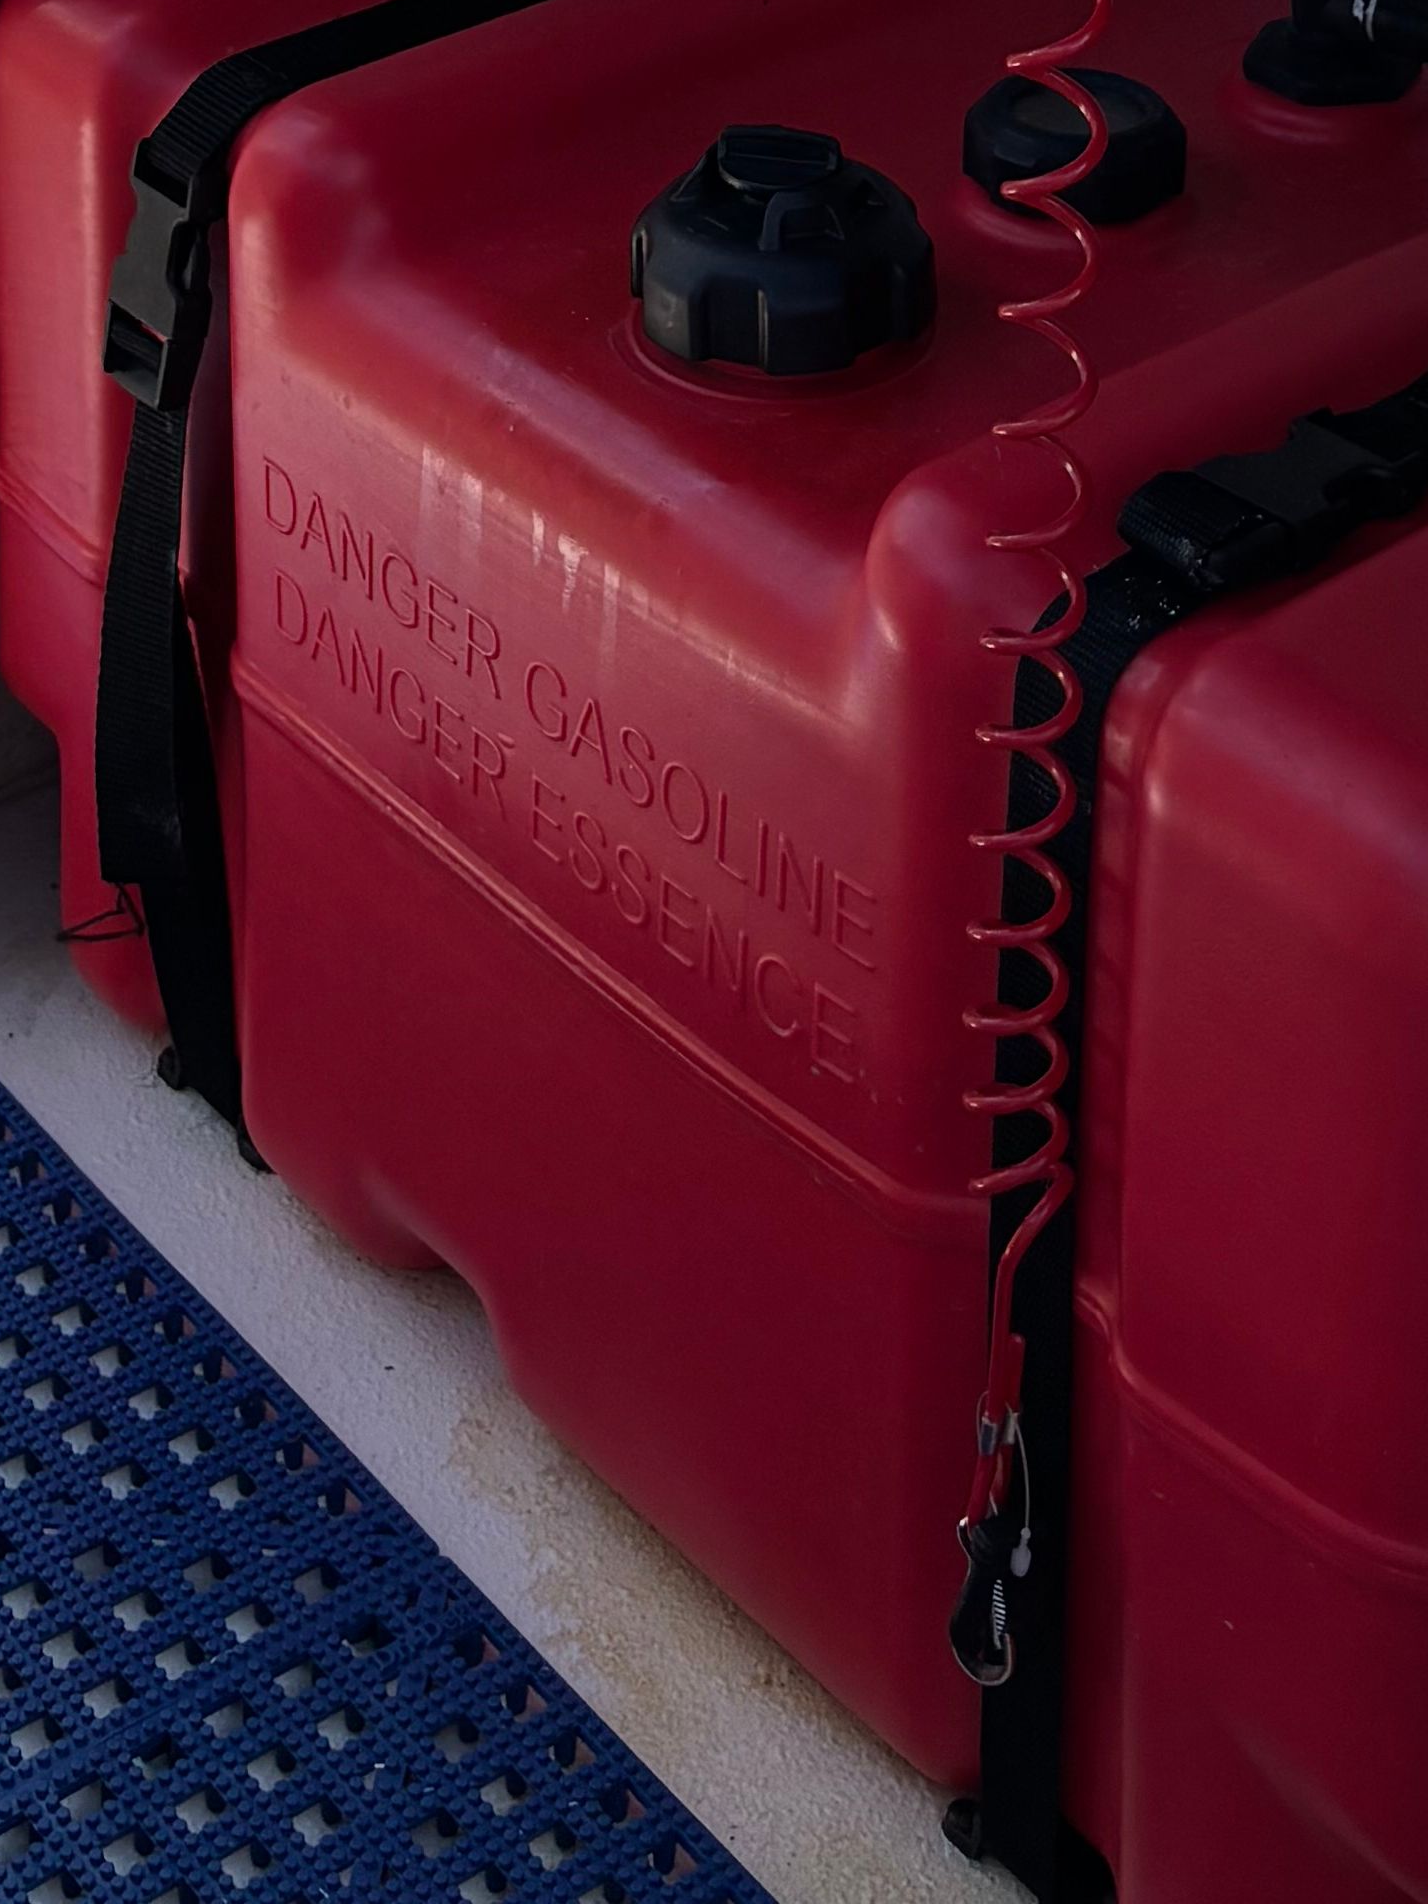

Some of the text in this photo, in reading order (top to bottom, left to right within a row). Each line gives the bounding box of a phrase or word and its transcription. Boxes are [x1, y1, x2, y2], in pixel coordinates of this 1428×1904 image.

[263, 455, 876, 972] DANGER GASOLINE
[274, 567, 857, 1084] DANGER ESSENCE
